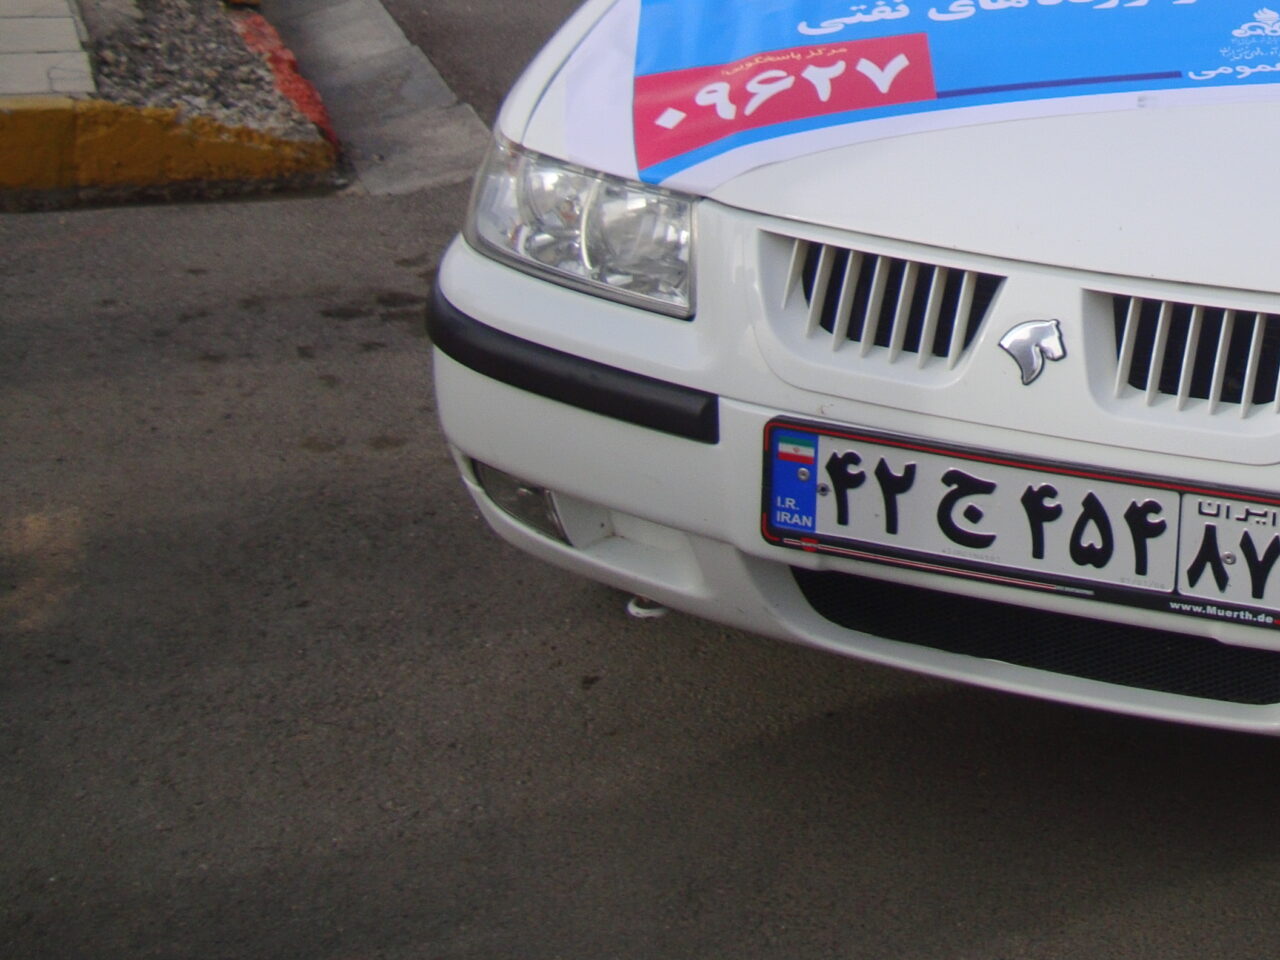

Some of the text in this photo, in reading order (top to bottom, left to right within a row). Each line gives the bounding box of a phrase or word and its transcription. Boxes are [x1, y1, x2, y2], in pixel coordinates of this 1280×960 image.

[653, 53, 910, 130] ۰۹۶۲۷
[776, 495, 800, 511] I.R.
[1198, 500, 1278, 528] ایران
[776, 510, 813, 528] IRAN
